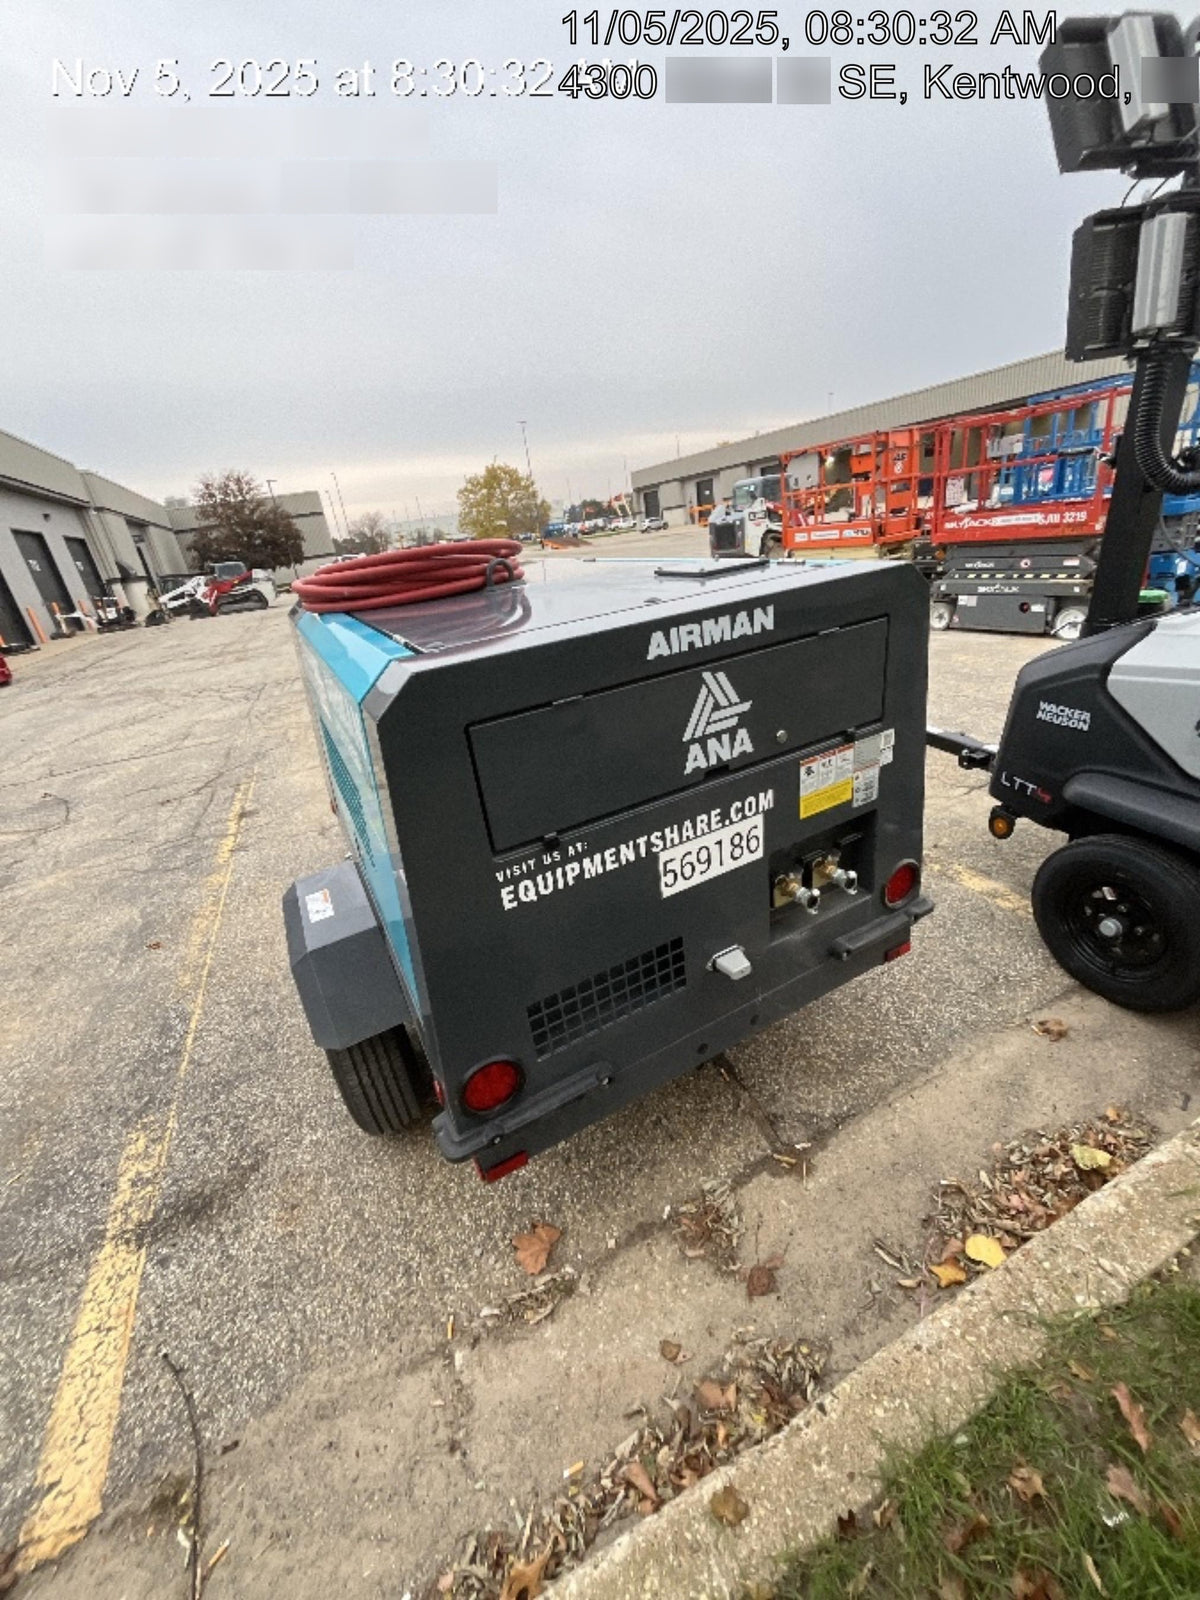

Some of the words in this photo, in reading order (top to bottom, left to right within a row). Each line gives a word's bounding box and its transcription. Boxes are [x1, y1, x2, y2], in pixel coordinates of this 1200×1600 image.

[647, 604, 775, 660] AIRMAN
[1036, 710, 1089, 731] NEUSON
[1040, 700, 1091, 724] WACKER
[683, 728, 754, 776] ANA
[496, 858, 536, 882] VISIT
[542, 851, 561, 865] US
[568, 841, 589, 857] AT:
[500, 788, 775, 911] EQUIPMENTSHARE.COM
[662, 824, 760, 888] 569186
